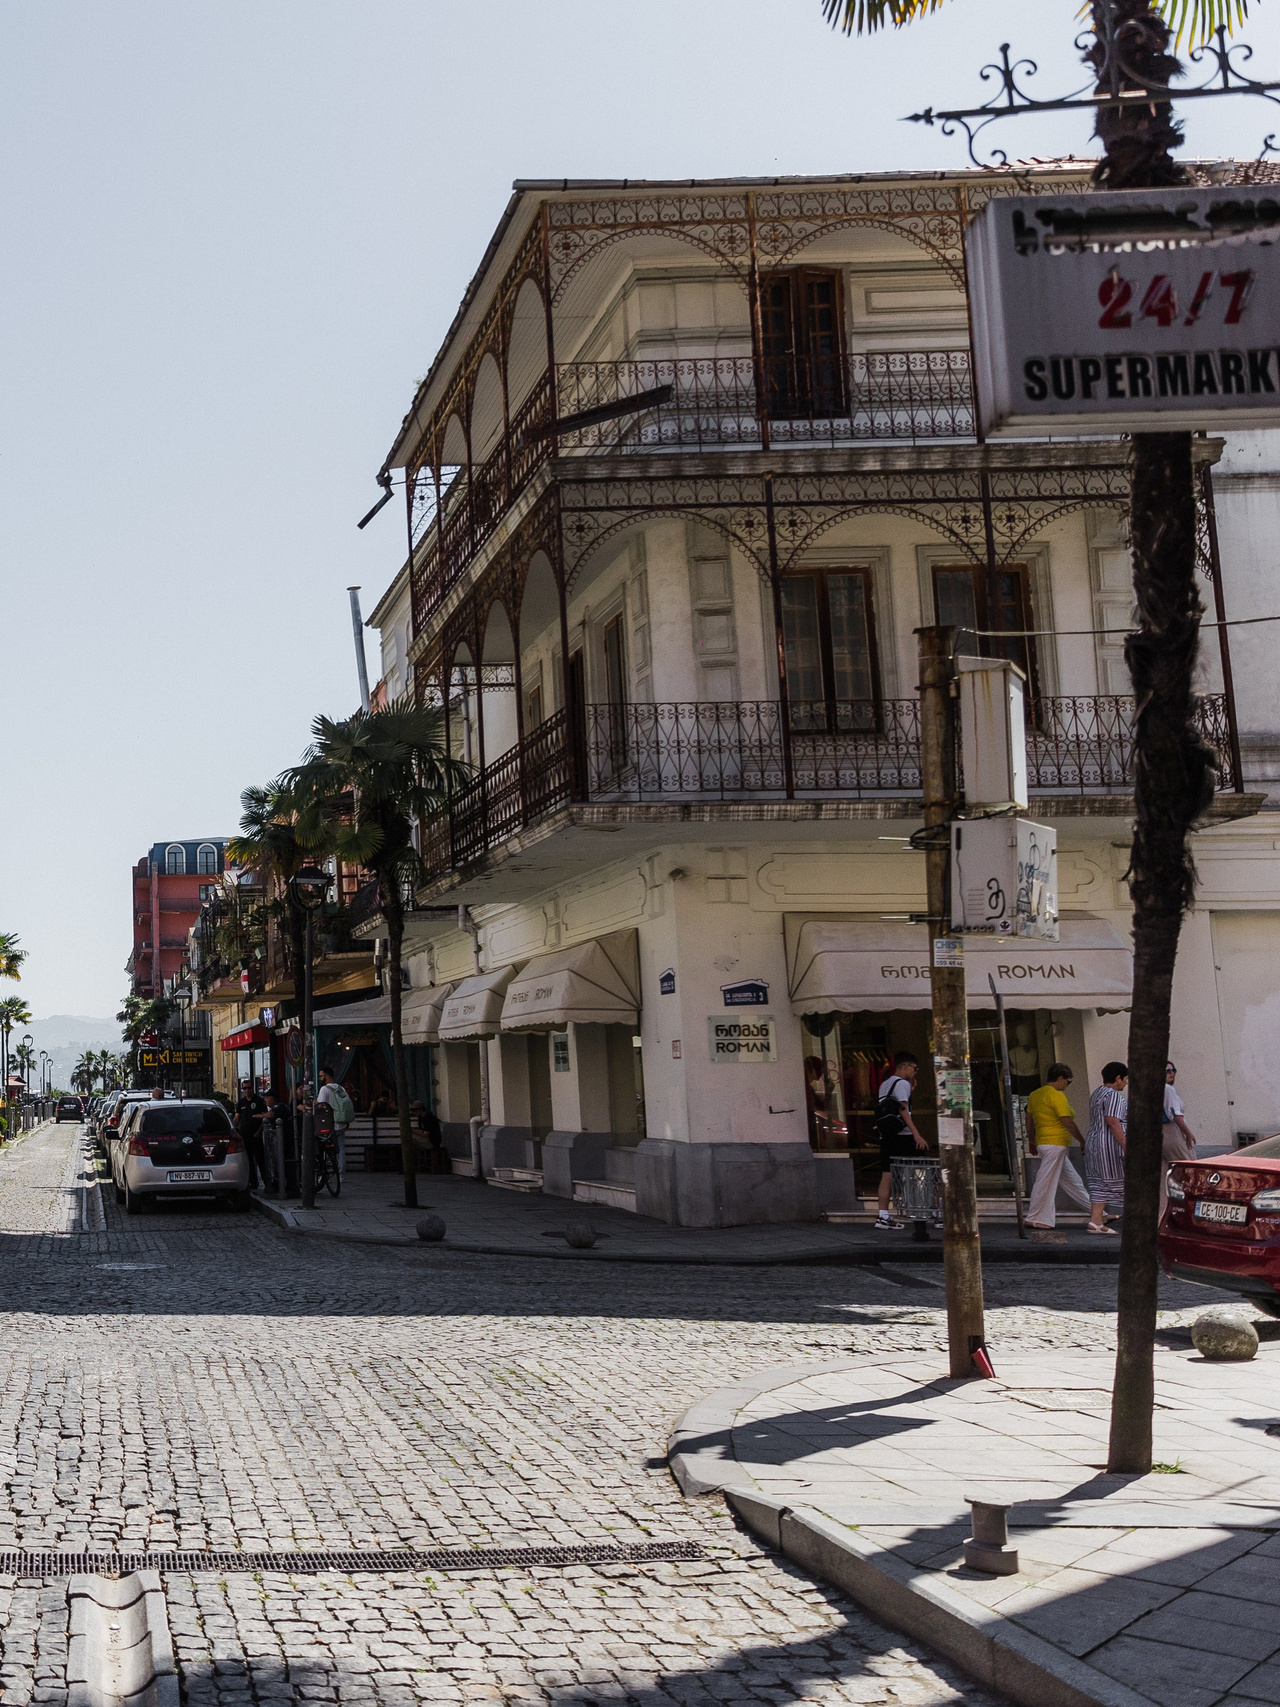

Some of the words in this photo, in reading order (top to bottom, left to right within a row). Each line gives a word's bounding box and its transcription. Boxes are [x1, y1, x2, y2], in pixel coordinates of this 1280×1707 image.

[1097, 269, 1260, 330] 24/7
[1023, 349, 1280, 402] SUPERMARK
[880, 964, 932, 979] რომ
[997, 964, 1076, 979] ROMAN
[535, 986, 554, 1000] ROMAN
[715, 1024, 769, 1037] რომან
[716, 1042, 770, 1053] ROMAN
[1201, 1203, 1241, 1220] CE-100-CE
